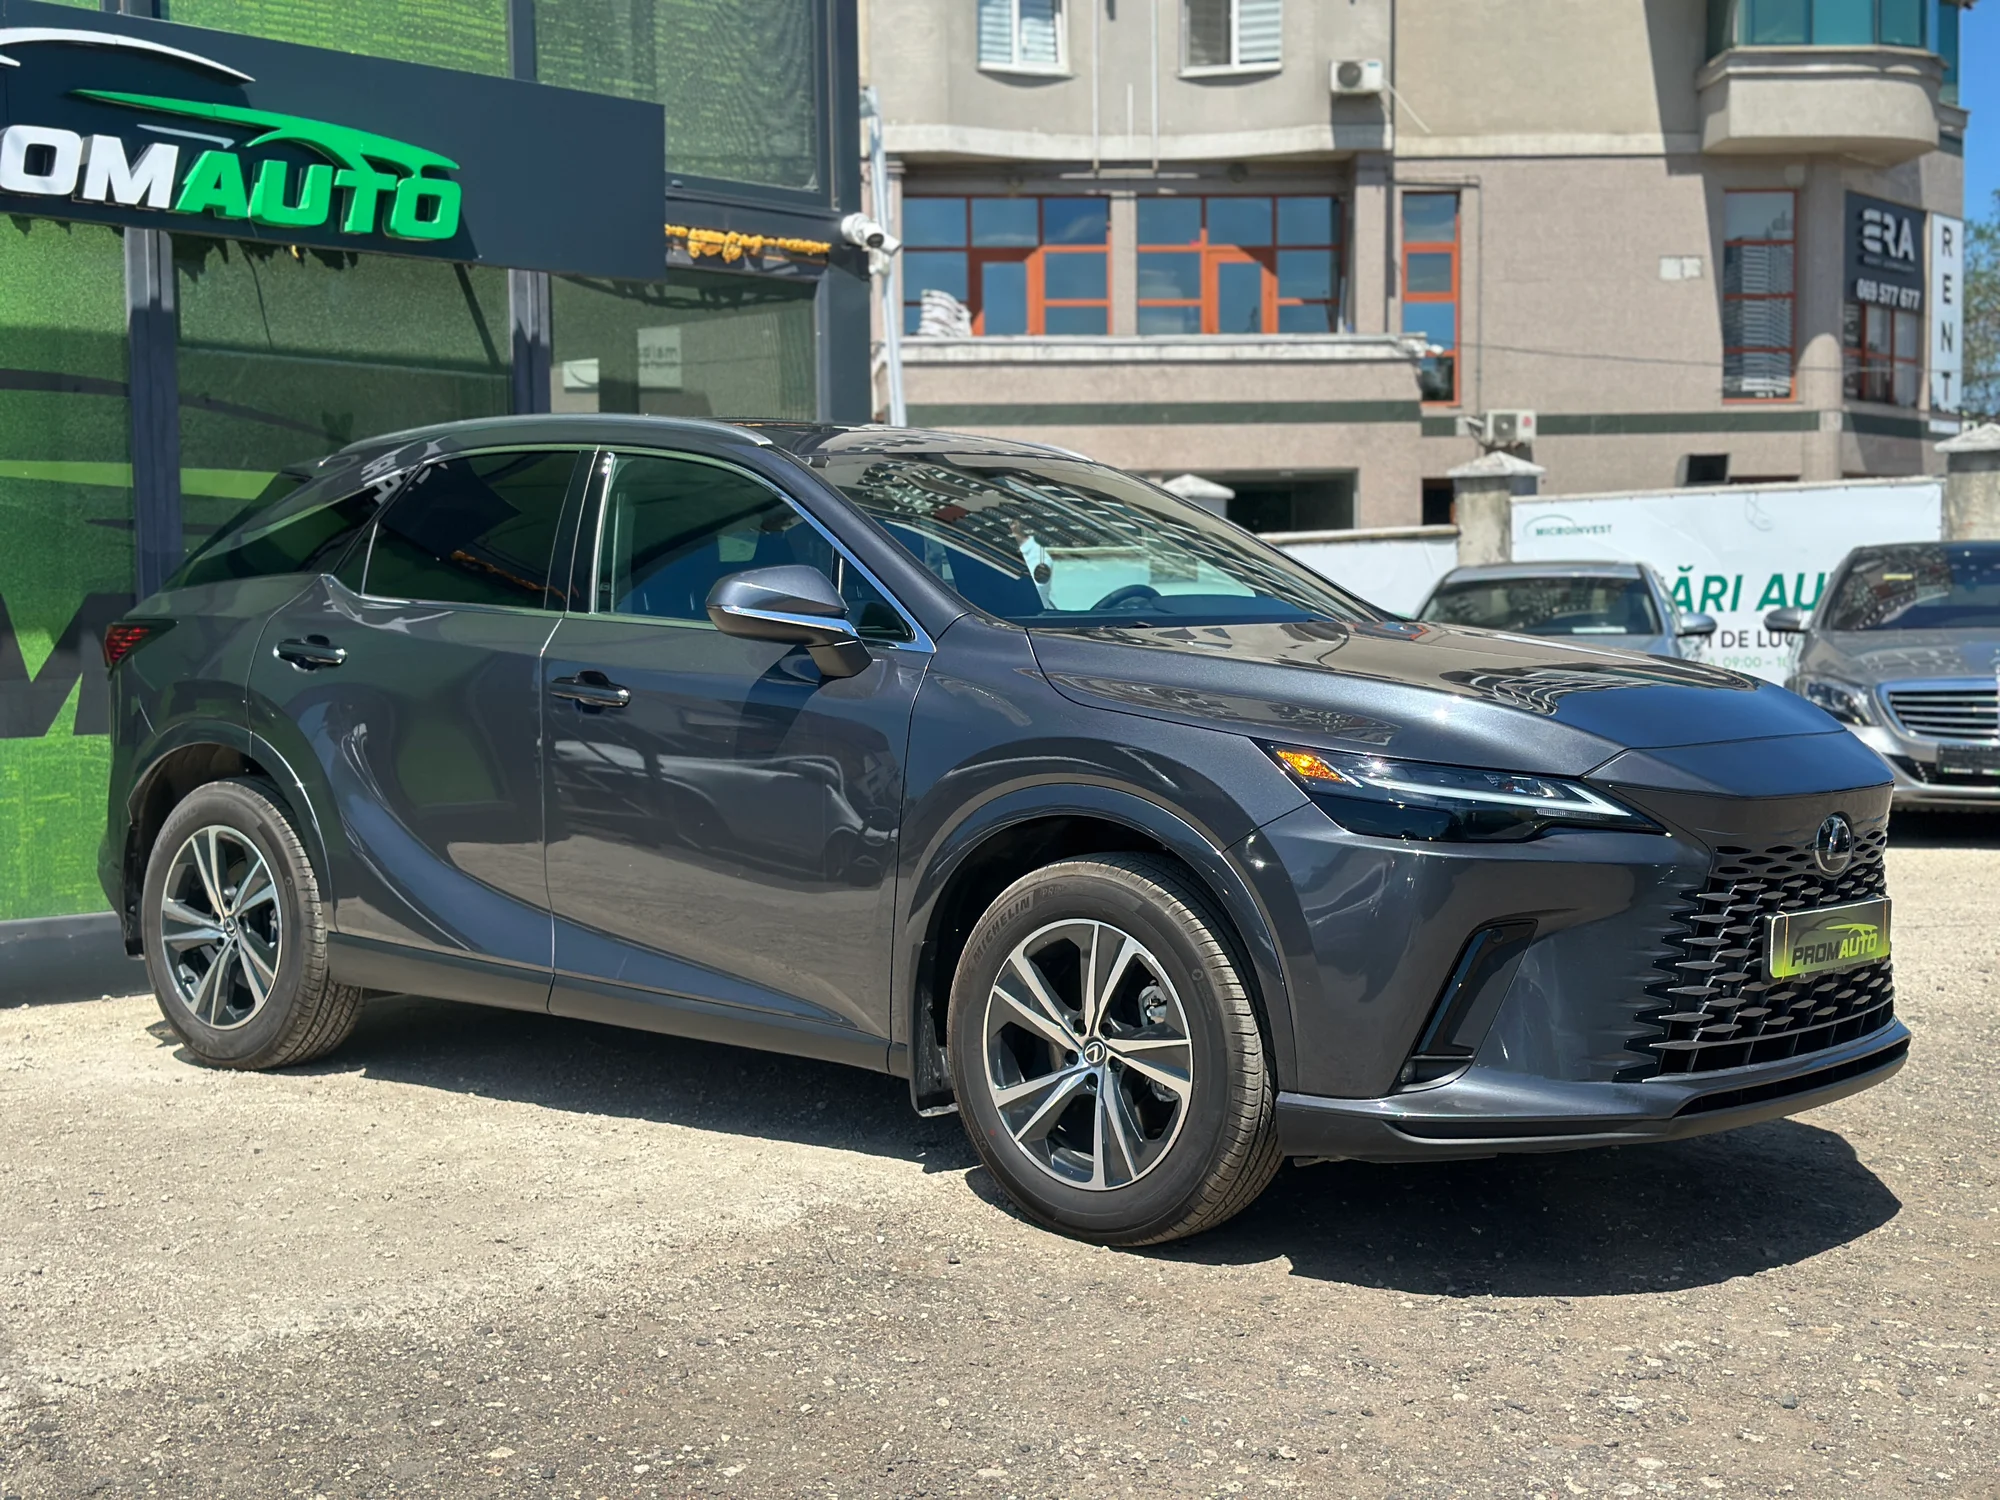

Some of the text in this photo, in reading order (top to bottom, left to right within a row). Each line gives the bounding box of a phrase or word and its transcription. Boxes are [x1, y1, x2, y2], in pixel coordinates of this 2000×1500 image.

[1863, 208, 1915, 262] ERA
[1941, 225, 1953, 402] RENT
[1536, 524, 1613, 536] MICROINVEST
[1672, 565, 1832, 612] ĂRI AU
[1721, 630, 1749, 648] DE
[1722, 656, 1761, 669] 09:00
[973, 896, 1030, 962] MICHELIN
[1791, 932, 1878, 967] PROMAUTO
